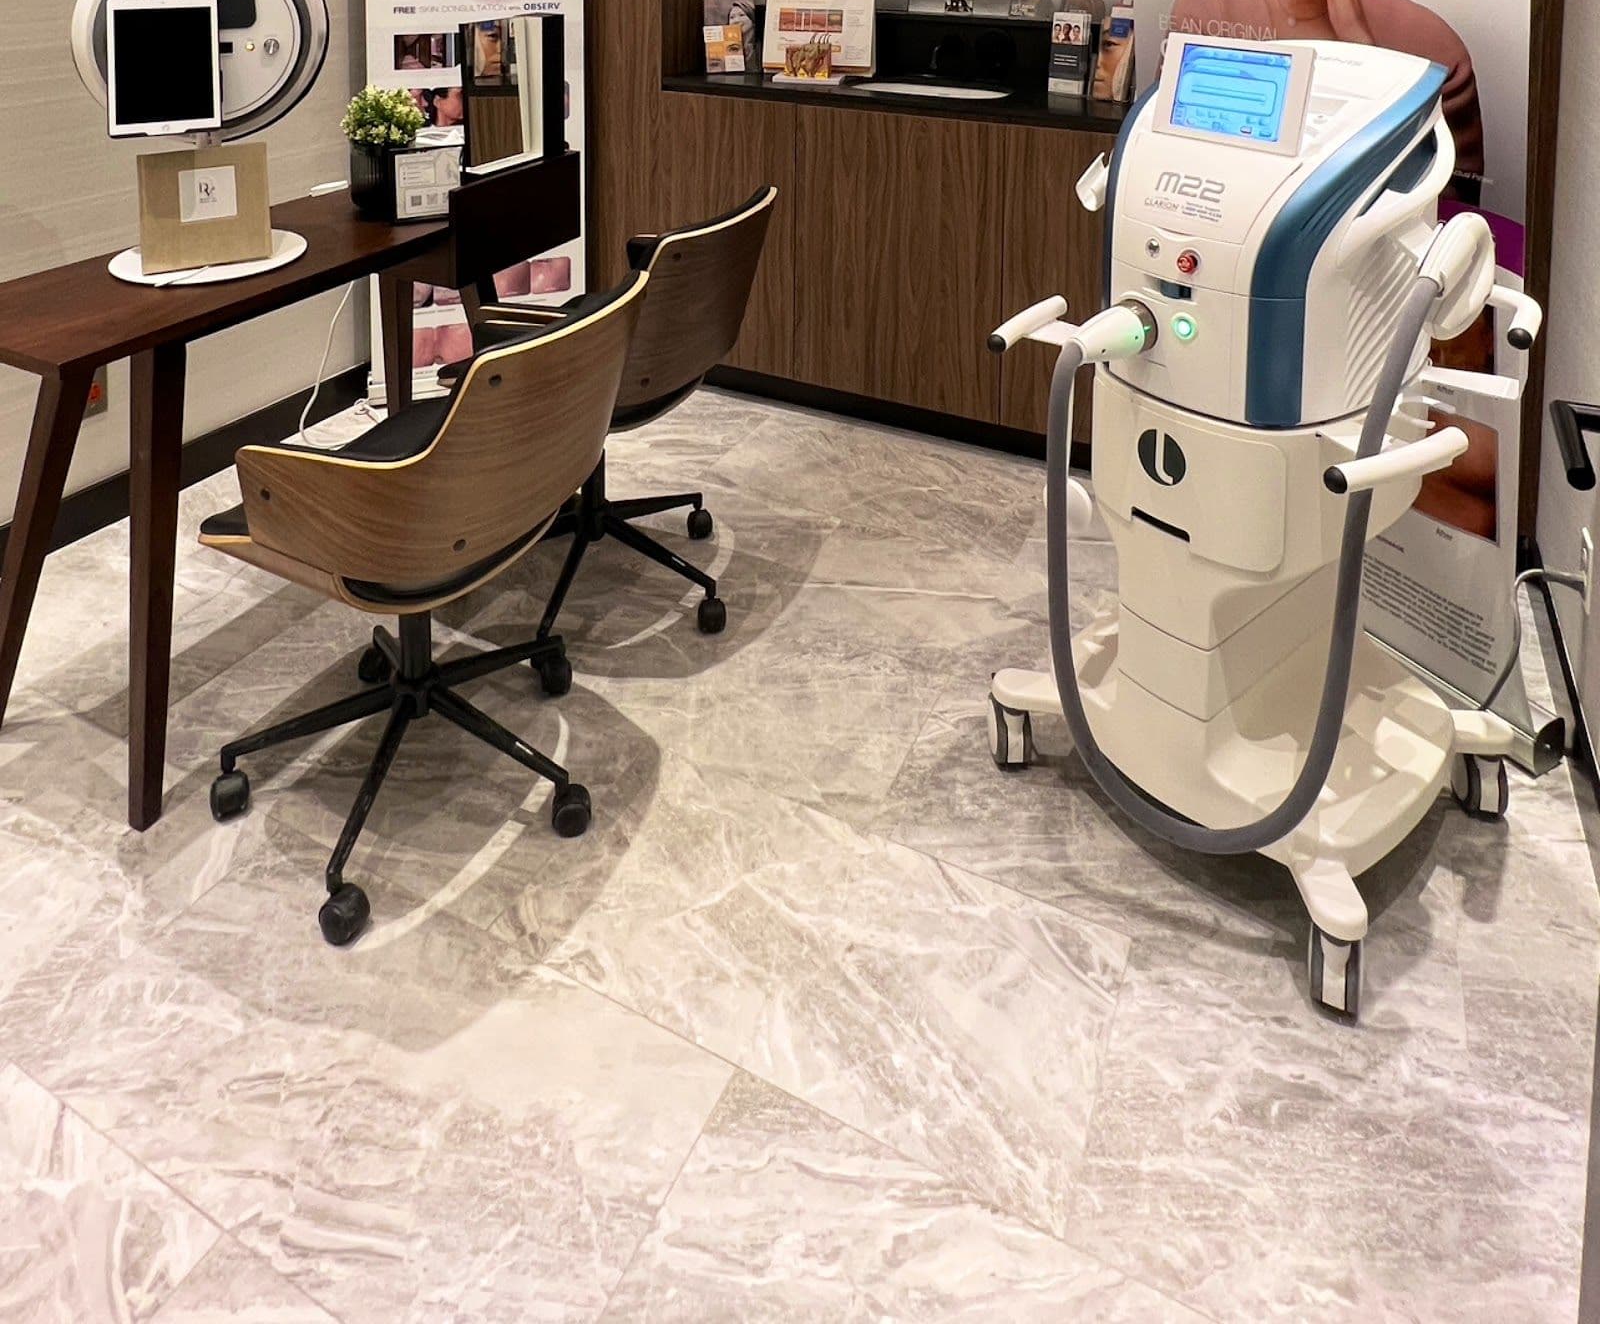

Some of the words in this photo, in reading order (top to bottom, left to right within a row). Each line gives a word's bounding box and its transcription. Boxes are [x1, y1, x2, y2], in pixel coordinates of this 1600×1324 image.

[393, 6, 416, 14] FREE
[441, 3, 506, 13] CONSULTATION
[523, 2, 561, 11] OBSERV
[1159, 11, 1177, 31] BE
[1181, 17, 1202, 34] AN
